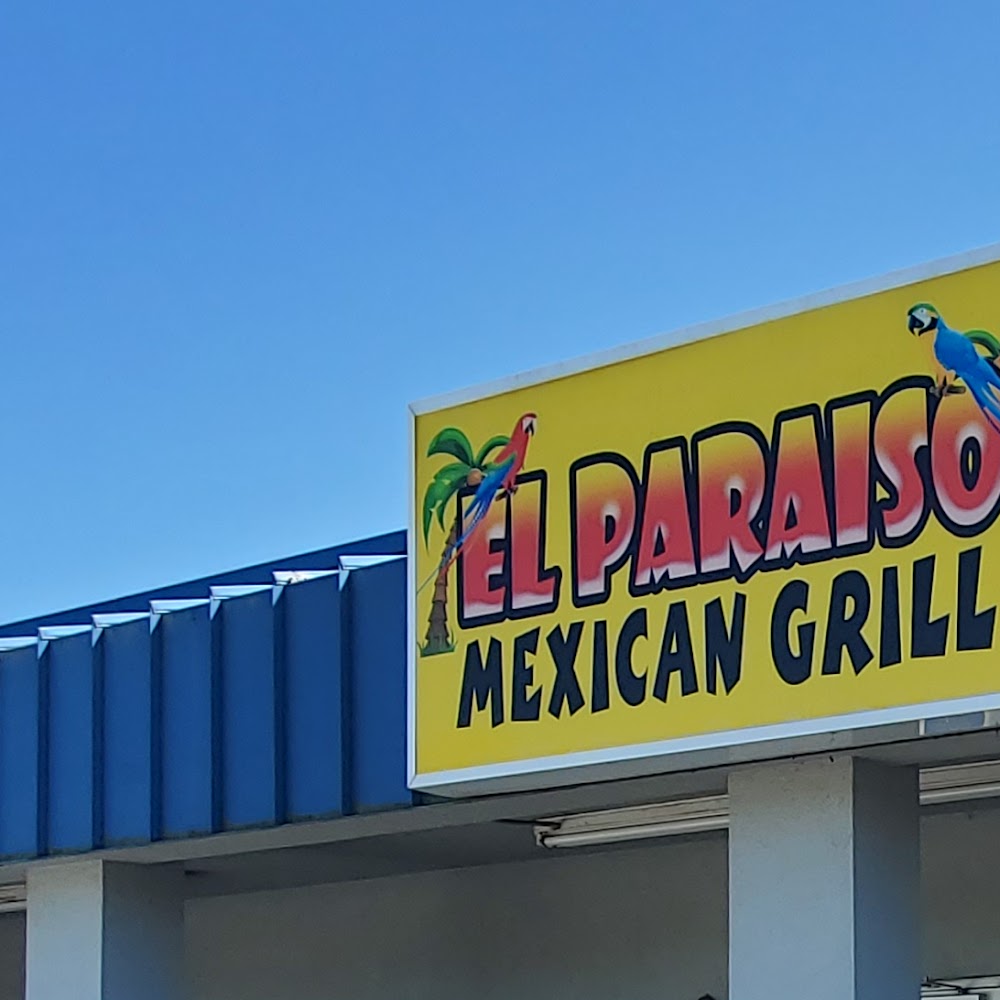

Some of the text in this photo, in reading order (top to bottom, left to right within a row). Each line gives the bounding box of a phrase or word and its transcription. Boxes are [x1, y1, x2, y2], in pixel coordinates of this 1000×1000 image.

[457, 469, 561, 629] EL
[456, 546, 997, 728] MEXICAN GRILL
